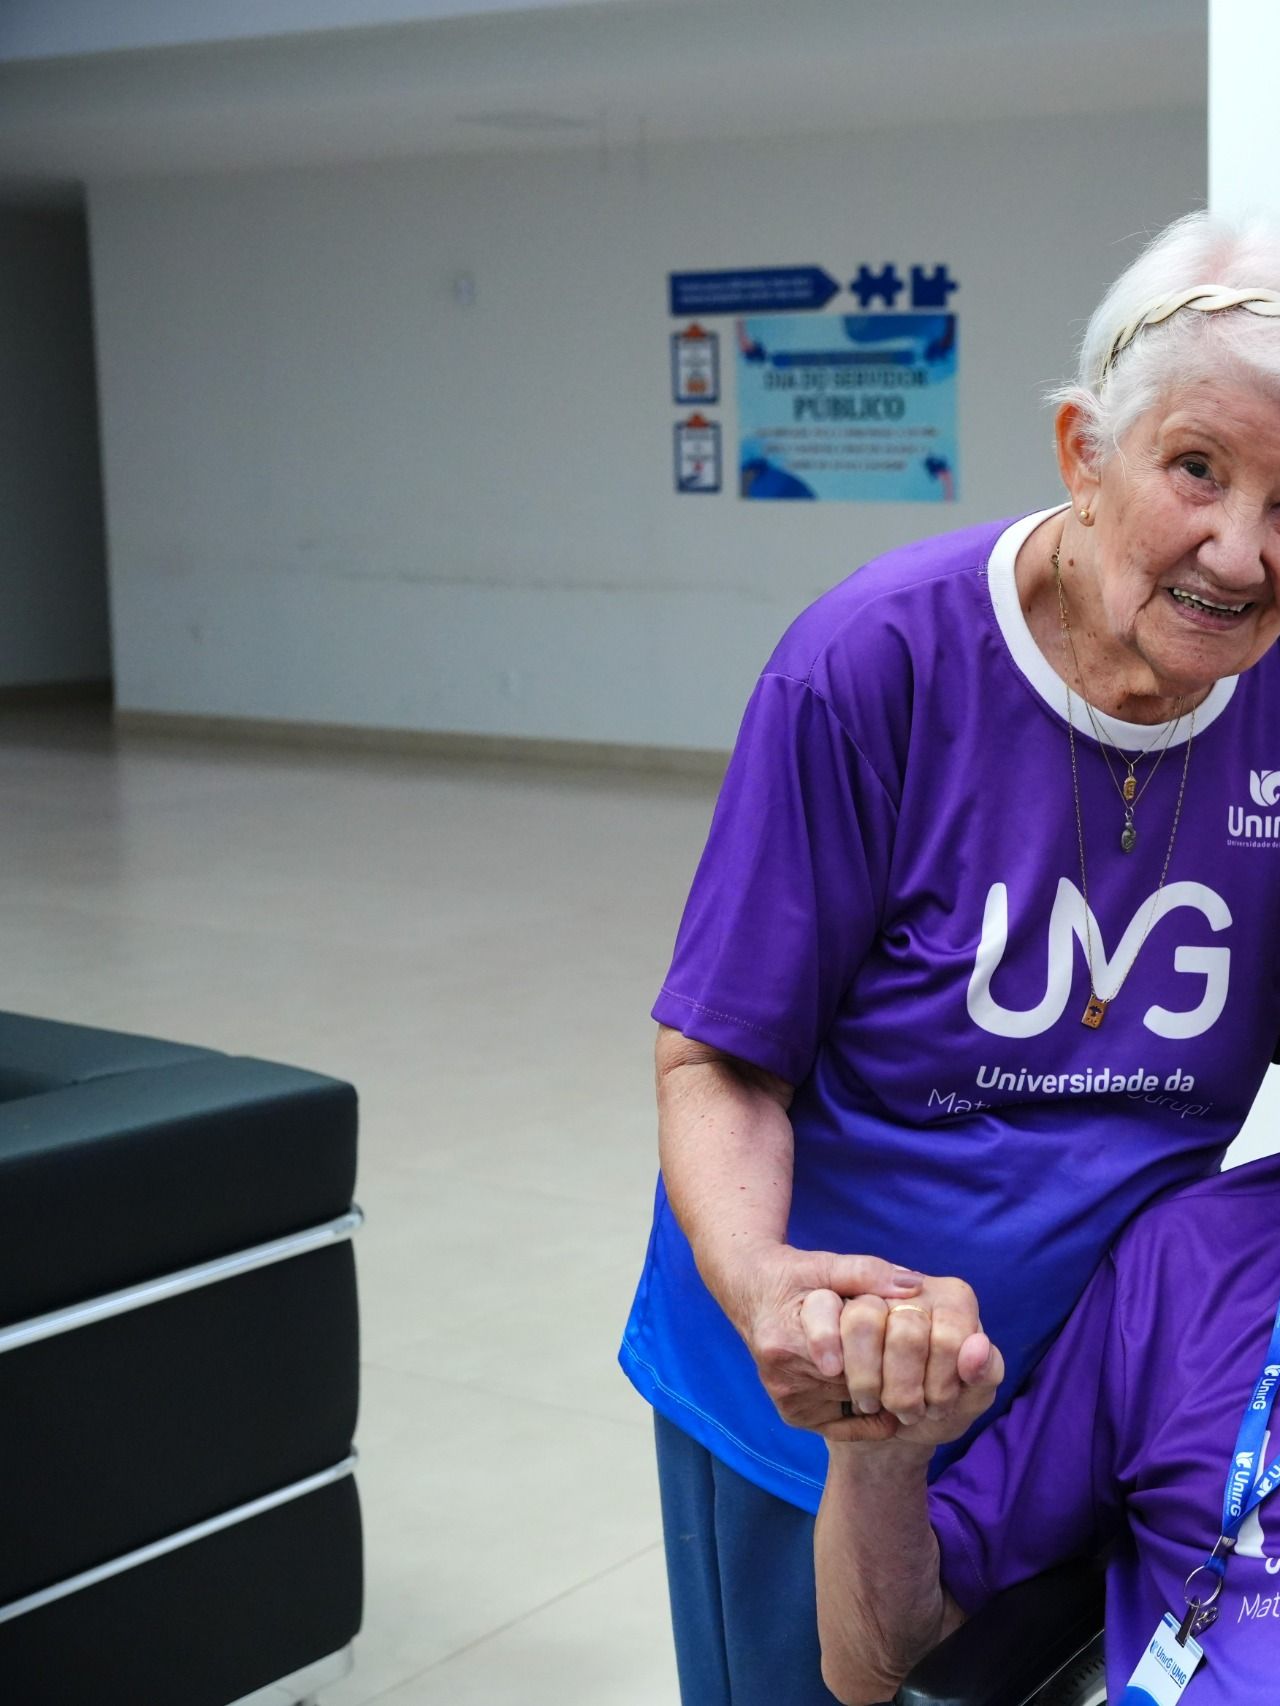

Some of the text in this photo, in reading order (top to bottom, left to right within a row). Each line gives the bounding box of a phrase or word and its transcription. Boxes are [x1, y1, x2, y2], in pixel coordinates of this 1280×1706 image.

[833, 368, 928, 388] SERVIDOR
[966, 877, 1233, 1039] UMG
[976, 1066, 1195, 1093] Universidade da
